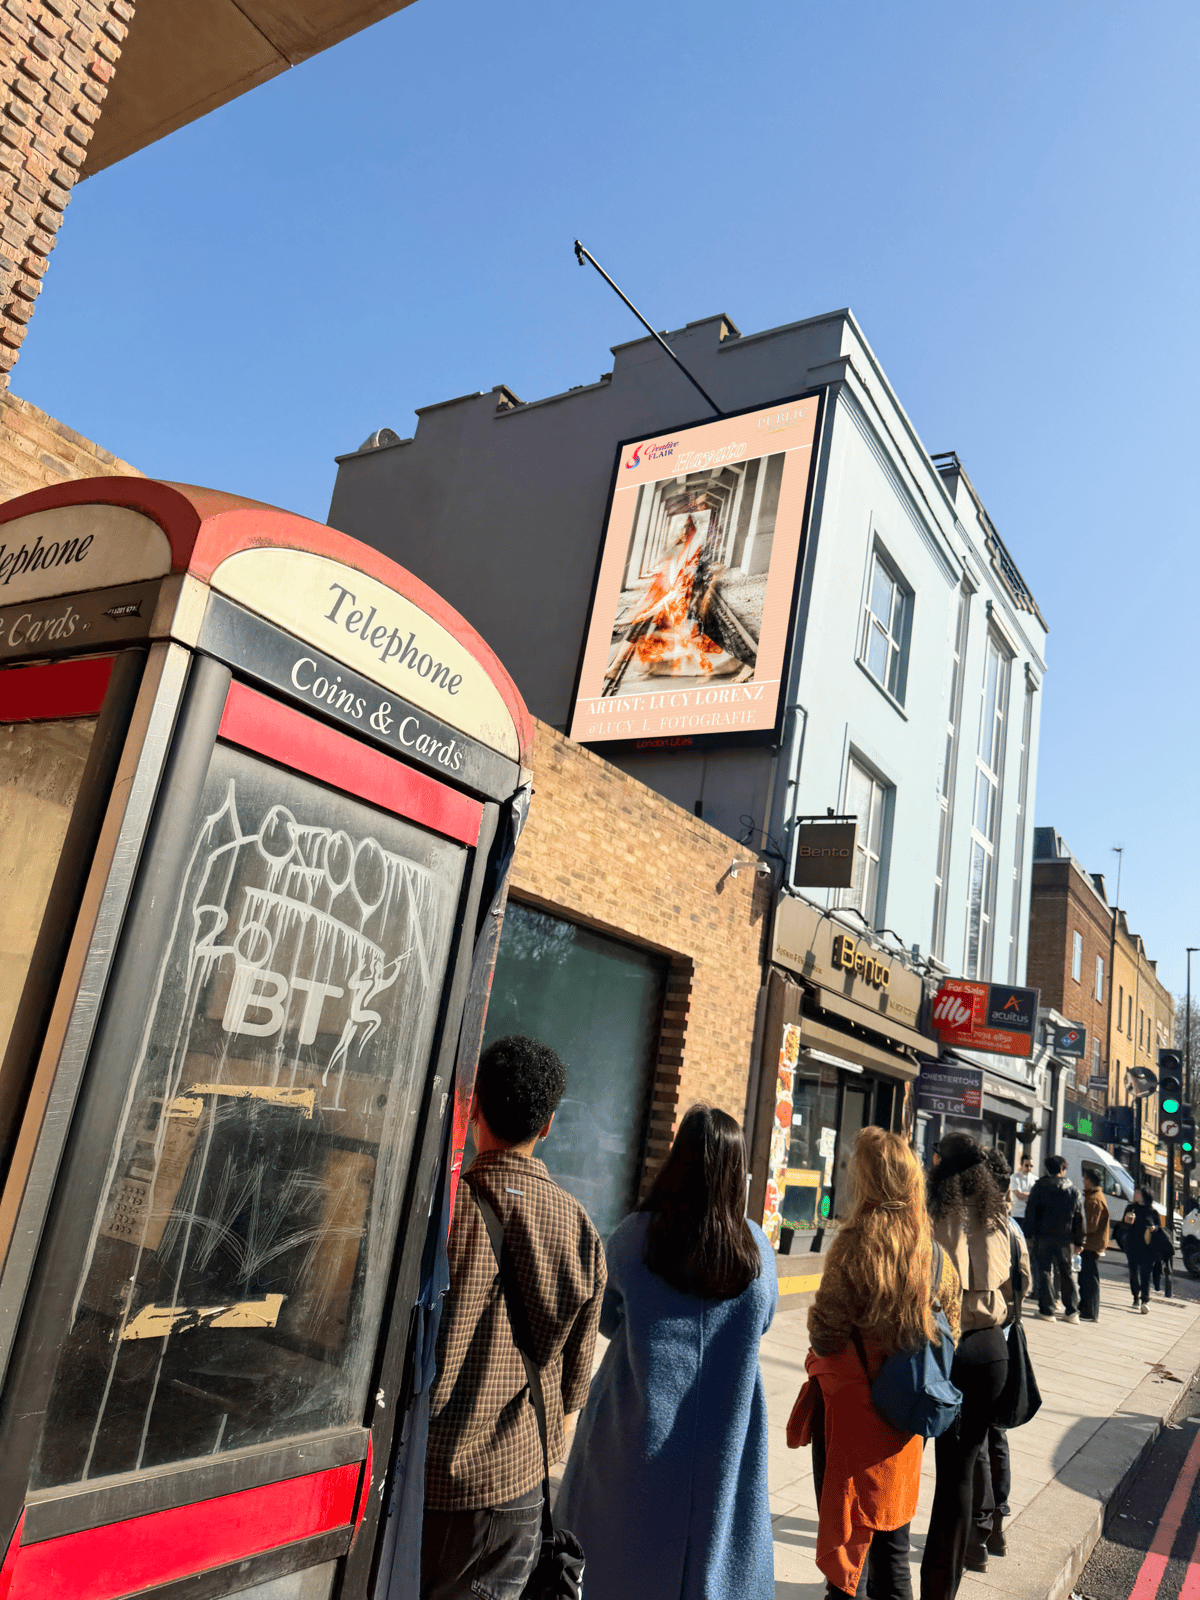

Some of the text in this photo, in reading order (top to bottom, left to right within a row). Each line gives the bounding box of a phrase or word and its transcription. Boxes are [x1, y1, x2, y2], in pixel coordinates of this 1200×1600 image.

[757, 406, 809, 429] PUBLIC
[643, 440, 680, 456] Creative
[648, 449, 674, 461] FLAIR
[672, 441, 748, 474] Hayato
[8, 606, 80, 647] Cards
[324, 582, 463, 695] Telephone
[586, 685, 765, 715] ARTIST: LUCY LORENZ
[291, 657, 463, 770] Coins & Cards
[799, 845, 850, 858] Bento
[840, 934, 891, 988] Bento
[948, 982, 985, 996] For Sale
[222, 965, 345, 1045] BT
[933, 995, 971, 1029] illy
[991, 1010, 1029, 1024] acuitus
[921, 1072, 979, 1087] CHESTERTONS
[932, 1098, 966, 1114] To Let
